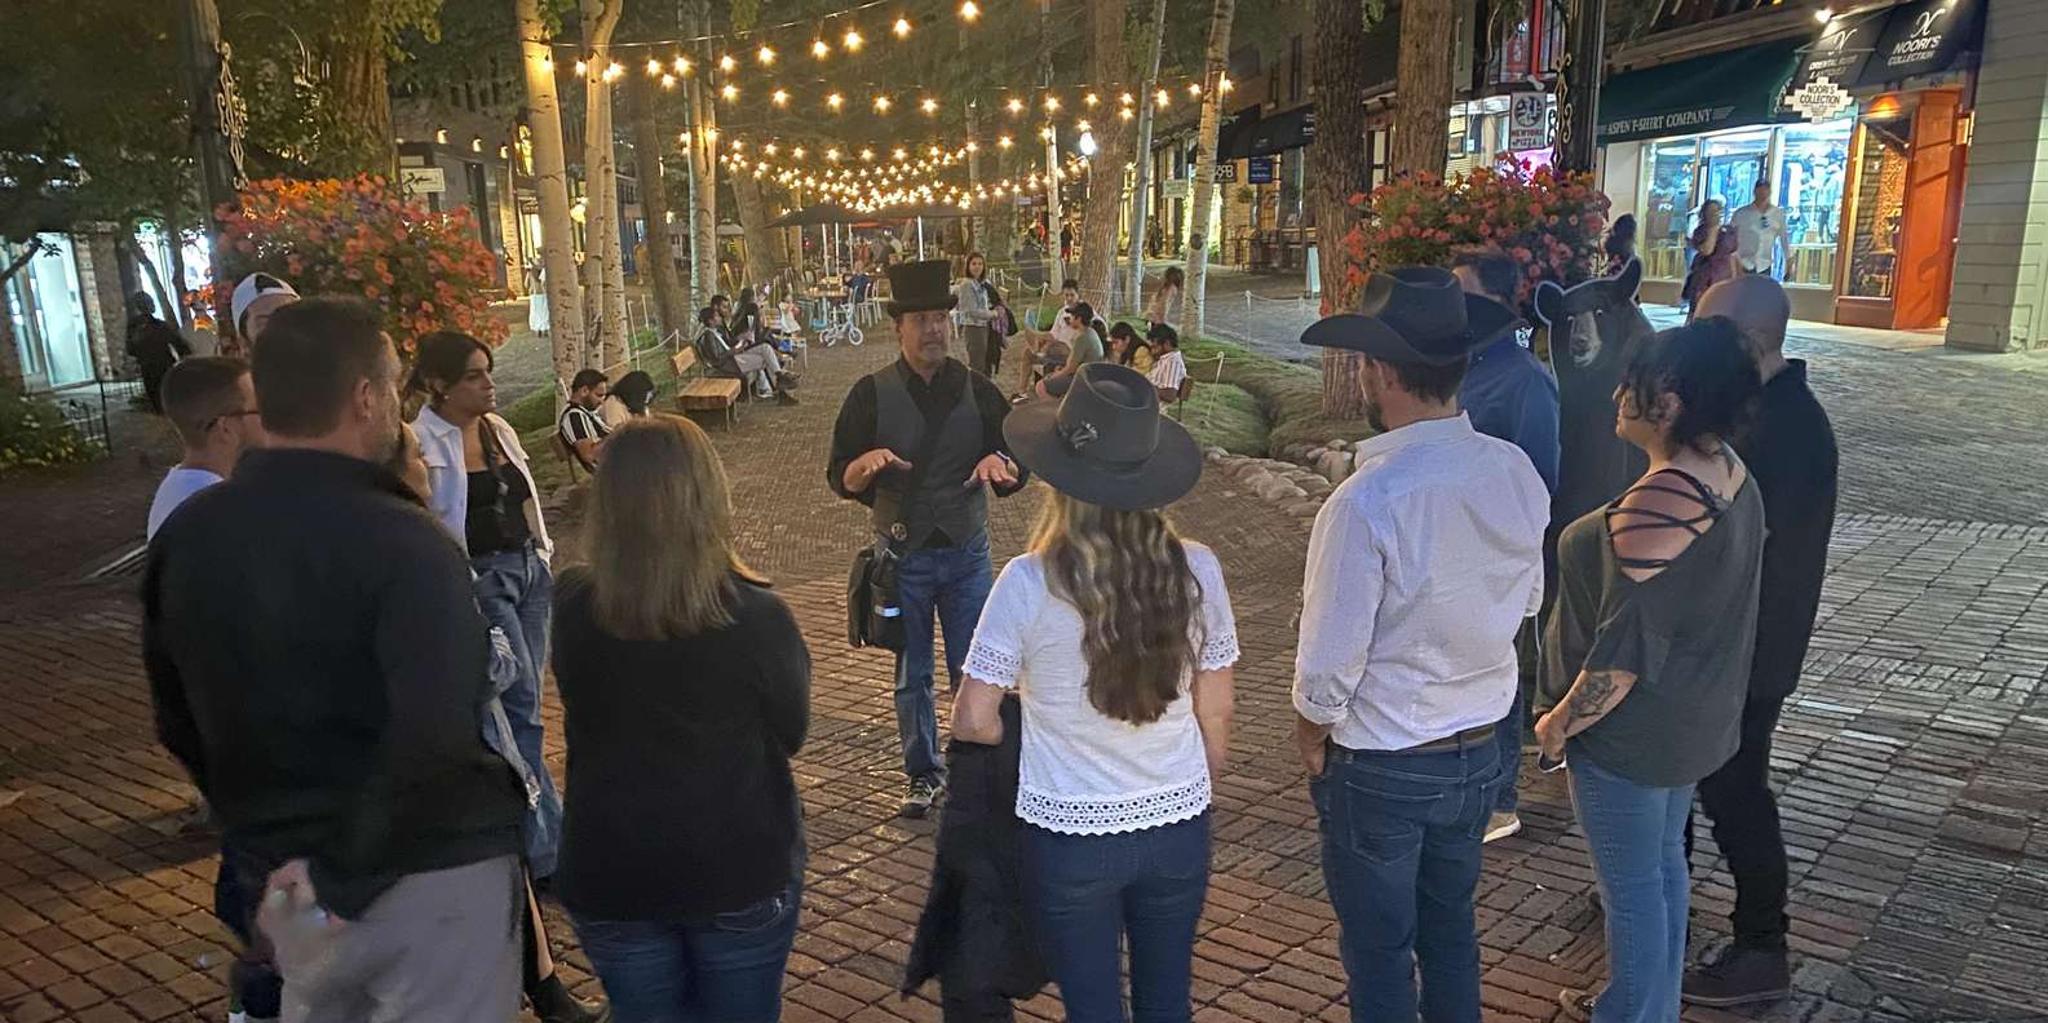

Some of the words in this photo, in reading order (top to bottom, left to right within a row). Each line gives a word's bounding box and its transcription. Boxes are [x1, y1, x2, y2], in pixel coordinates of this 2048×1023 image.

[1892, 35, 1942, 55] NOORI'S
[1887, 51, 1936, 66] COLLECTION
[1806, 84, 1836, 95] NOORI'S
[1800, 93, 1841, 105] COLLECTION
[1607, 120, 1631, 135] ASPEN
[1666, 108, 1713, 128] COMPANY
